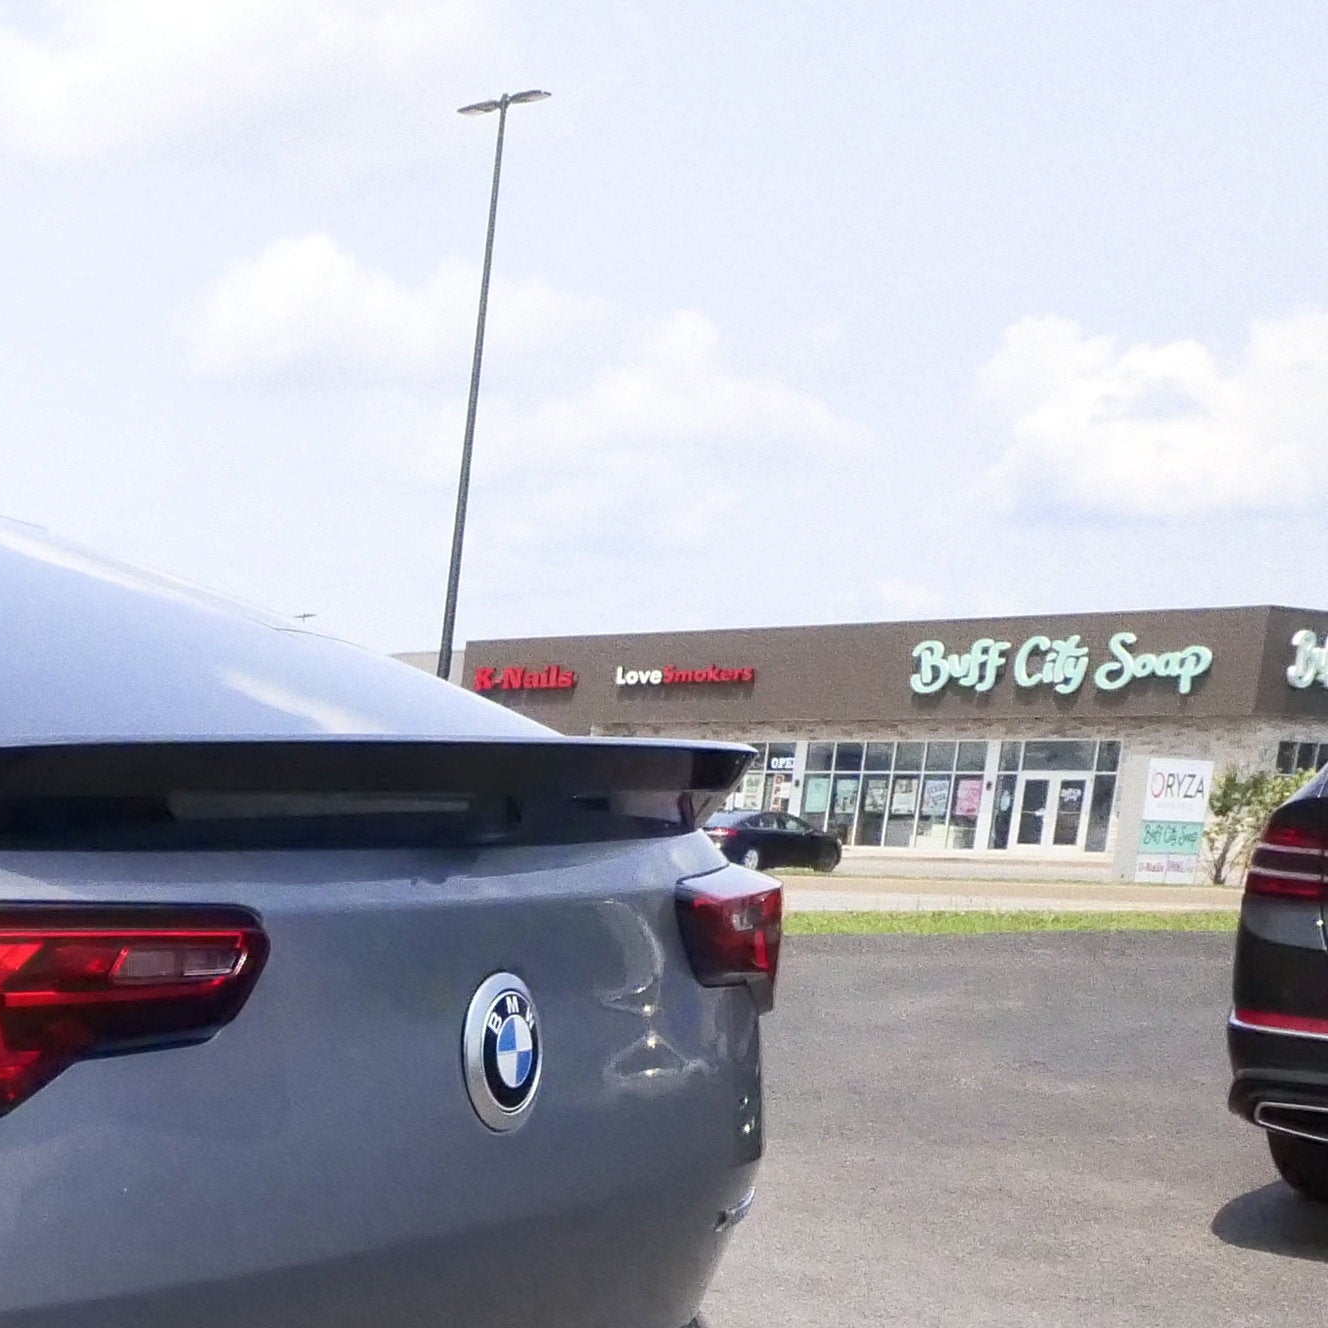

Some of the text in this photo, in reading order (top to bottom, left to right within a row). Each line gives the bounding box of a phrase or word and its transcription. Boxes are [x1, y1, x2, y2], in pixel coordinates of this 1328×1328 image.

[910, 632, 1213, 694] Buff City Soap
[473, 665, 575, 690] K-Nails
[771, 757, 795, 769] OPE
[1151, 772, 1204, 799] ORYZA
[488, 996, 535, 1034] BMW
